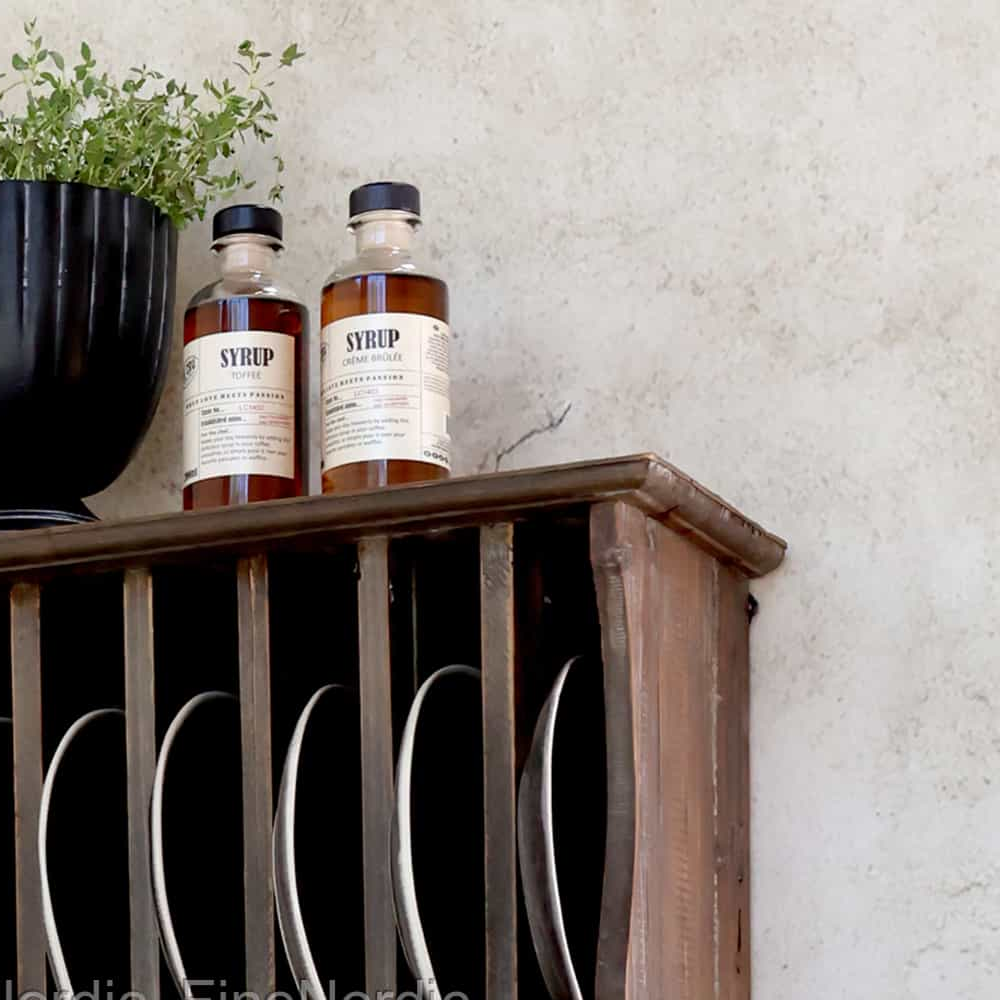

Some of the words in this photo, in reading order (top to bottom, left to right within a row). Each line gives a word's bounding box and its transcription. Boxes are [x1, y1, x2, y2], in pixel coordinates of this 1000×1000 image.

[347, 329, 400, 352] SYRUP
[220, 347, 274, 368] SYRUP
[231, 370, 262, 380] TOFFEE
